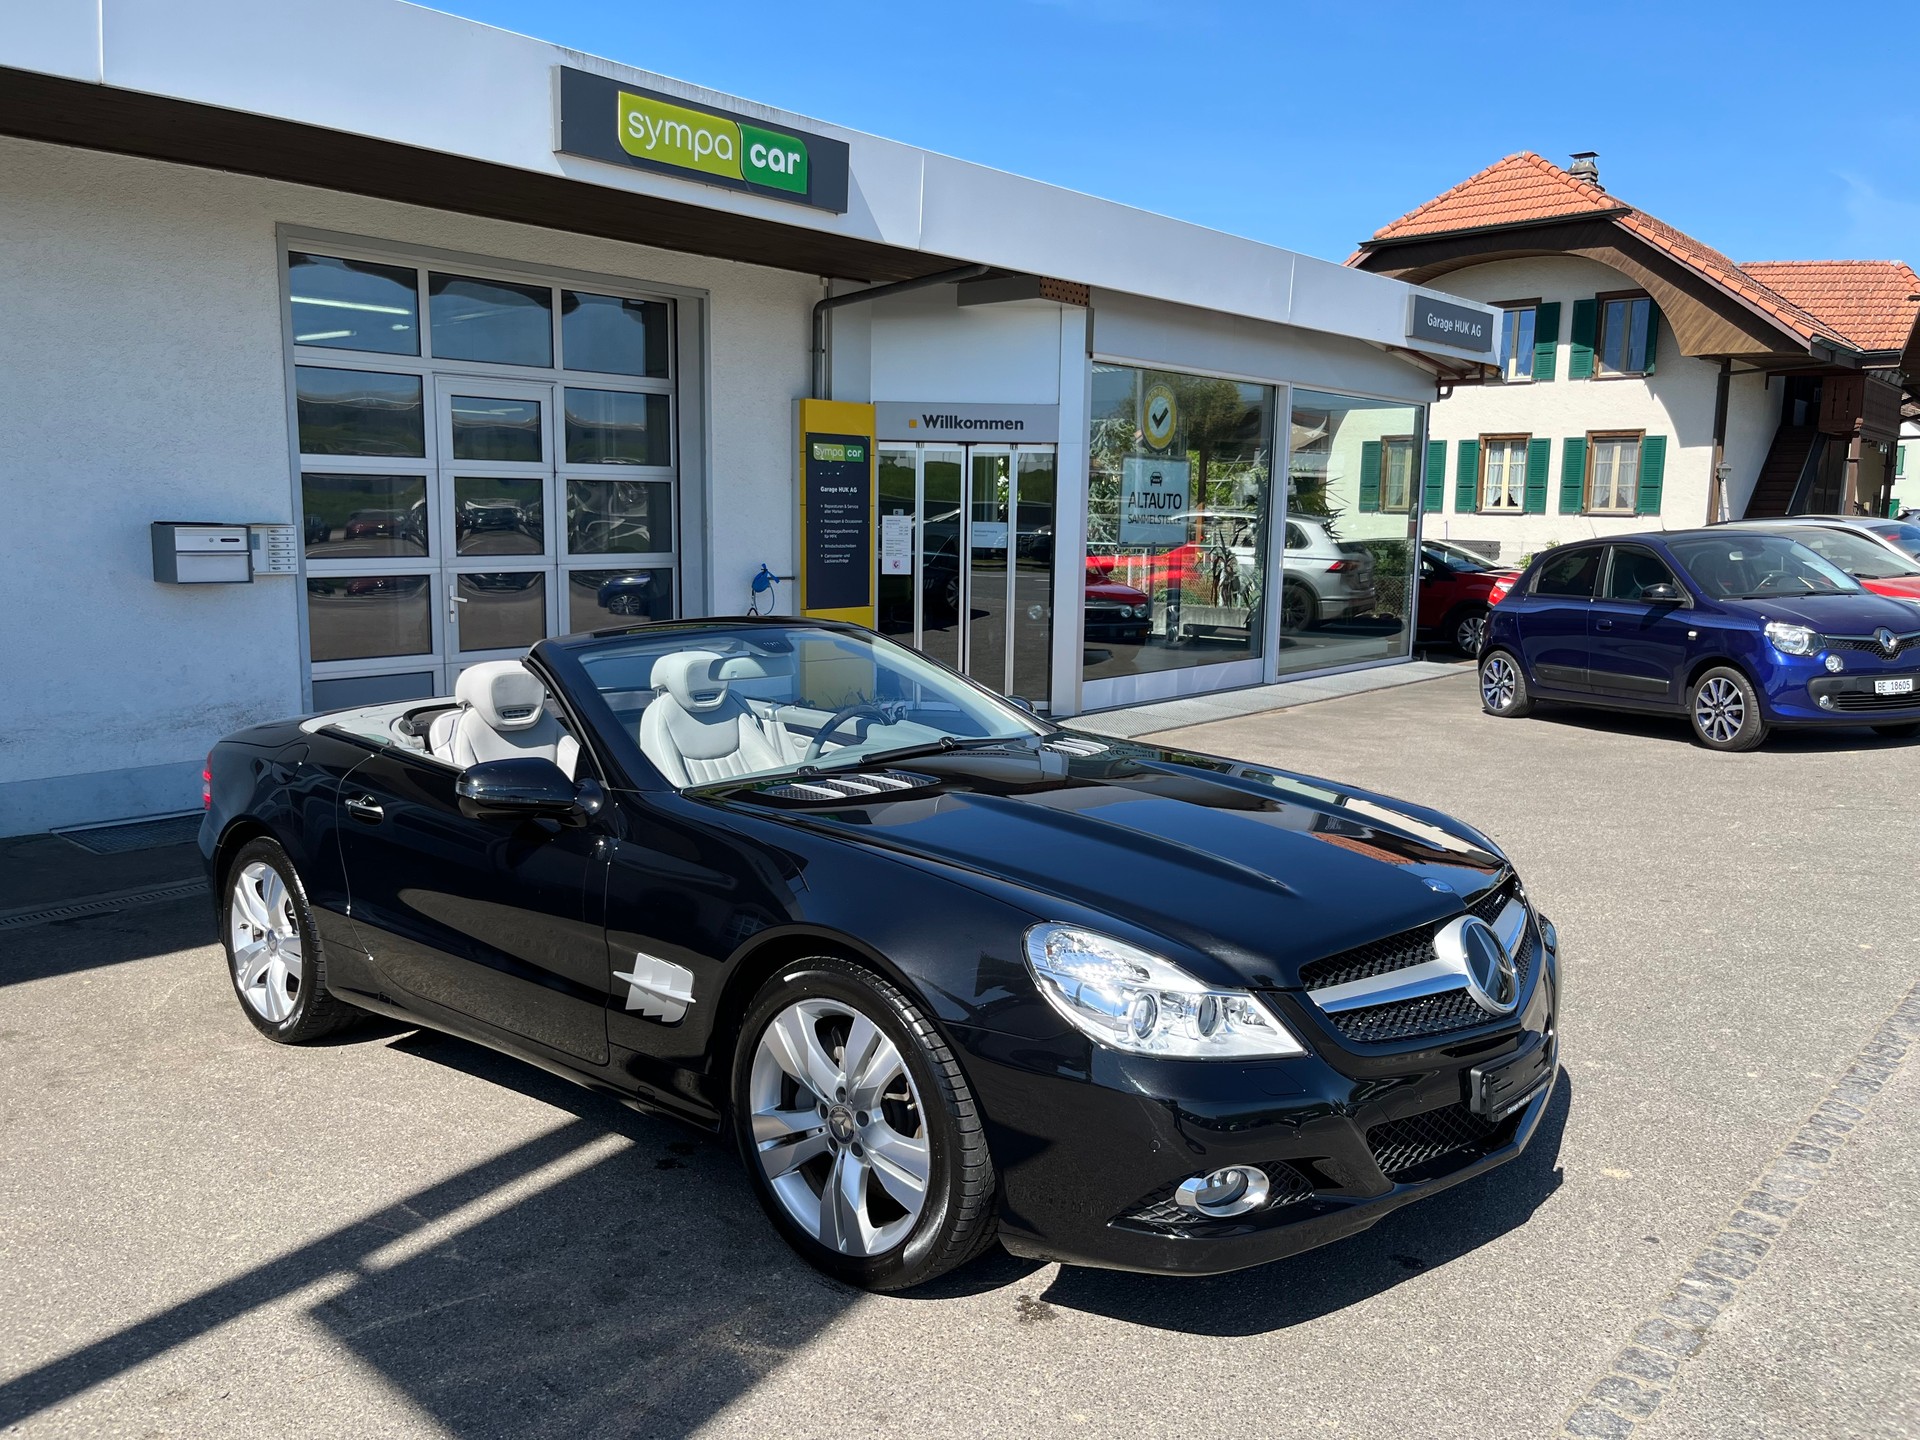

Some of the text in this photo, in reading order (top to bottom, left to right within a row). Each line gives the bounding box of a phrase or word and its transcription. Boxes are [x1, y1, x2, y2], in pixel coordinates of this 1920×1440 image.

[628, 112, 800, 175] sympa car
[1427, 313, 1482, 338] Garage HUK AG
[922, 414, 1024, 430] Willkommen
[847, 449, 862, 457] car
[1128, 491, 1182, 509] ALTAUTO
[1891, 681, 1911, 690] 18605
